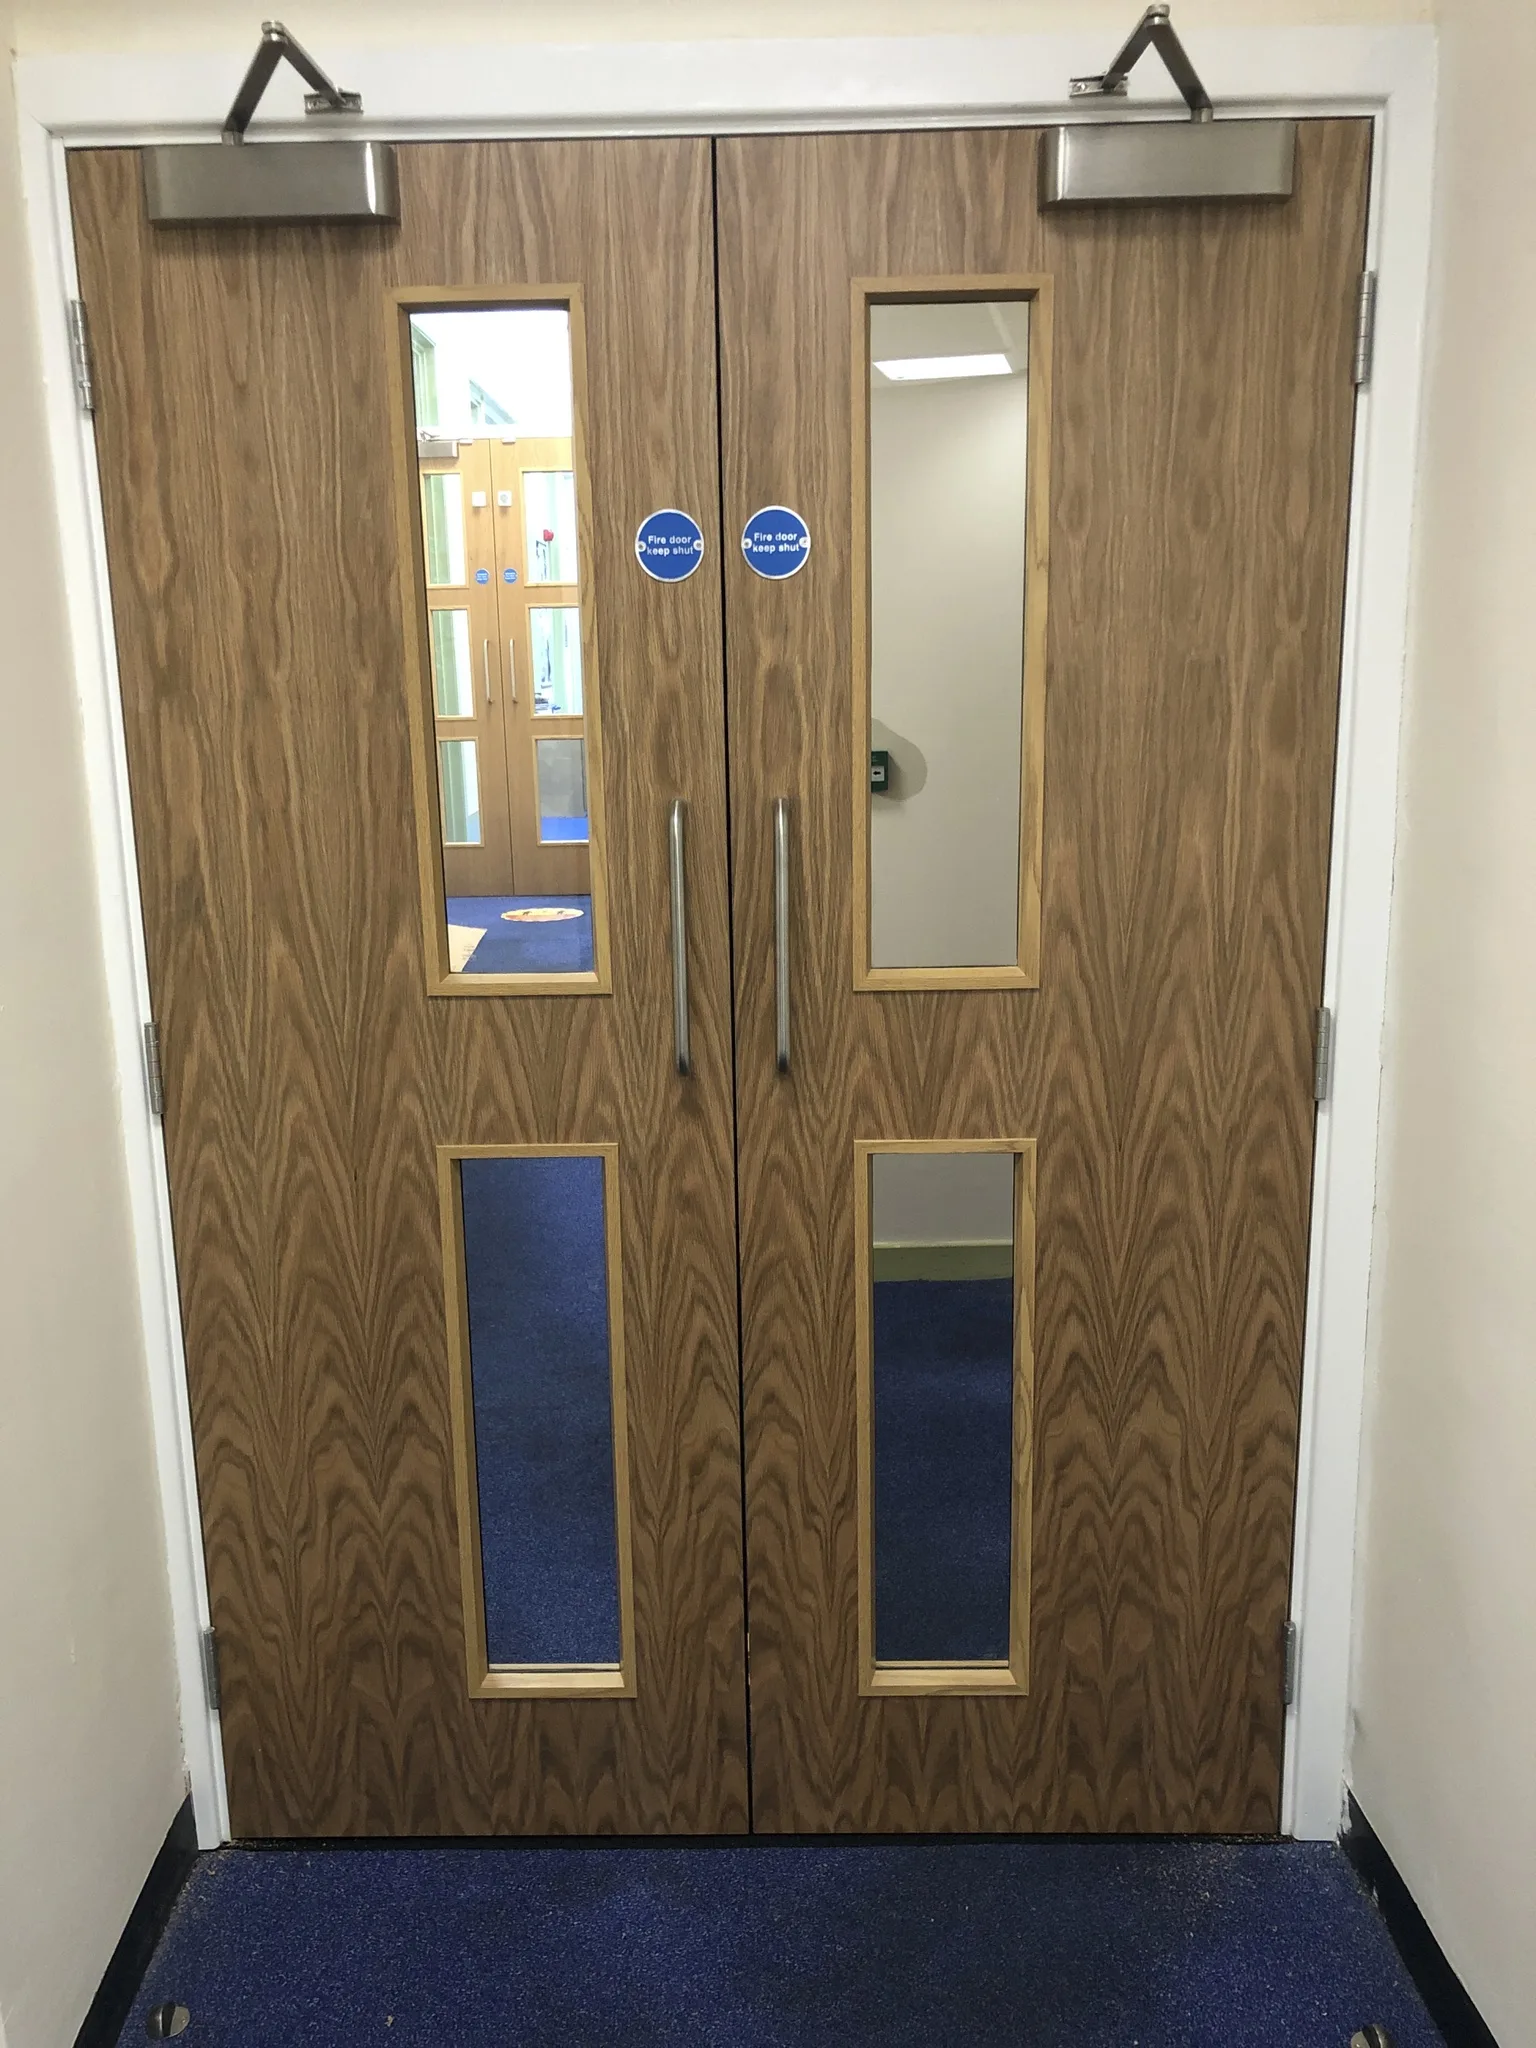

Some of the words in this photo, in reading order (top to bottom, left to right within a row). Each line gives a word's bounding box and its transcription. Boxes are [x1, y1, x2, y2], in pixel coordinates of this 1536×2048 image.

[648, 535, 667, 544] Fire
[669, 535, 692, 544] door
[754, 532, 773, 541] Fire
[775, 532, 798, 541] door
[647, 546, 670, 557] keep
[673, 546, 694, 555] shut
[753, 543, 776, 554] keep
[778, 543, 800, 552] shut
